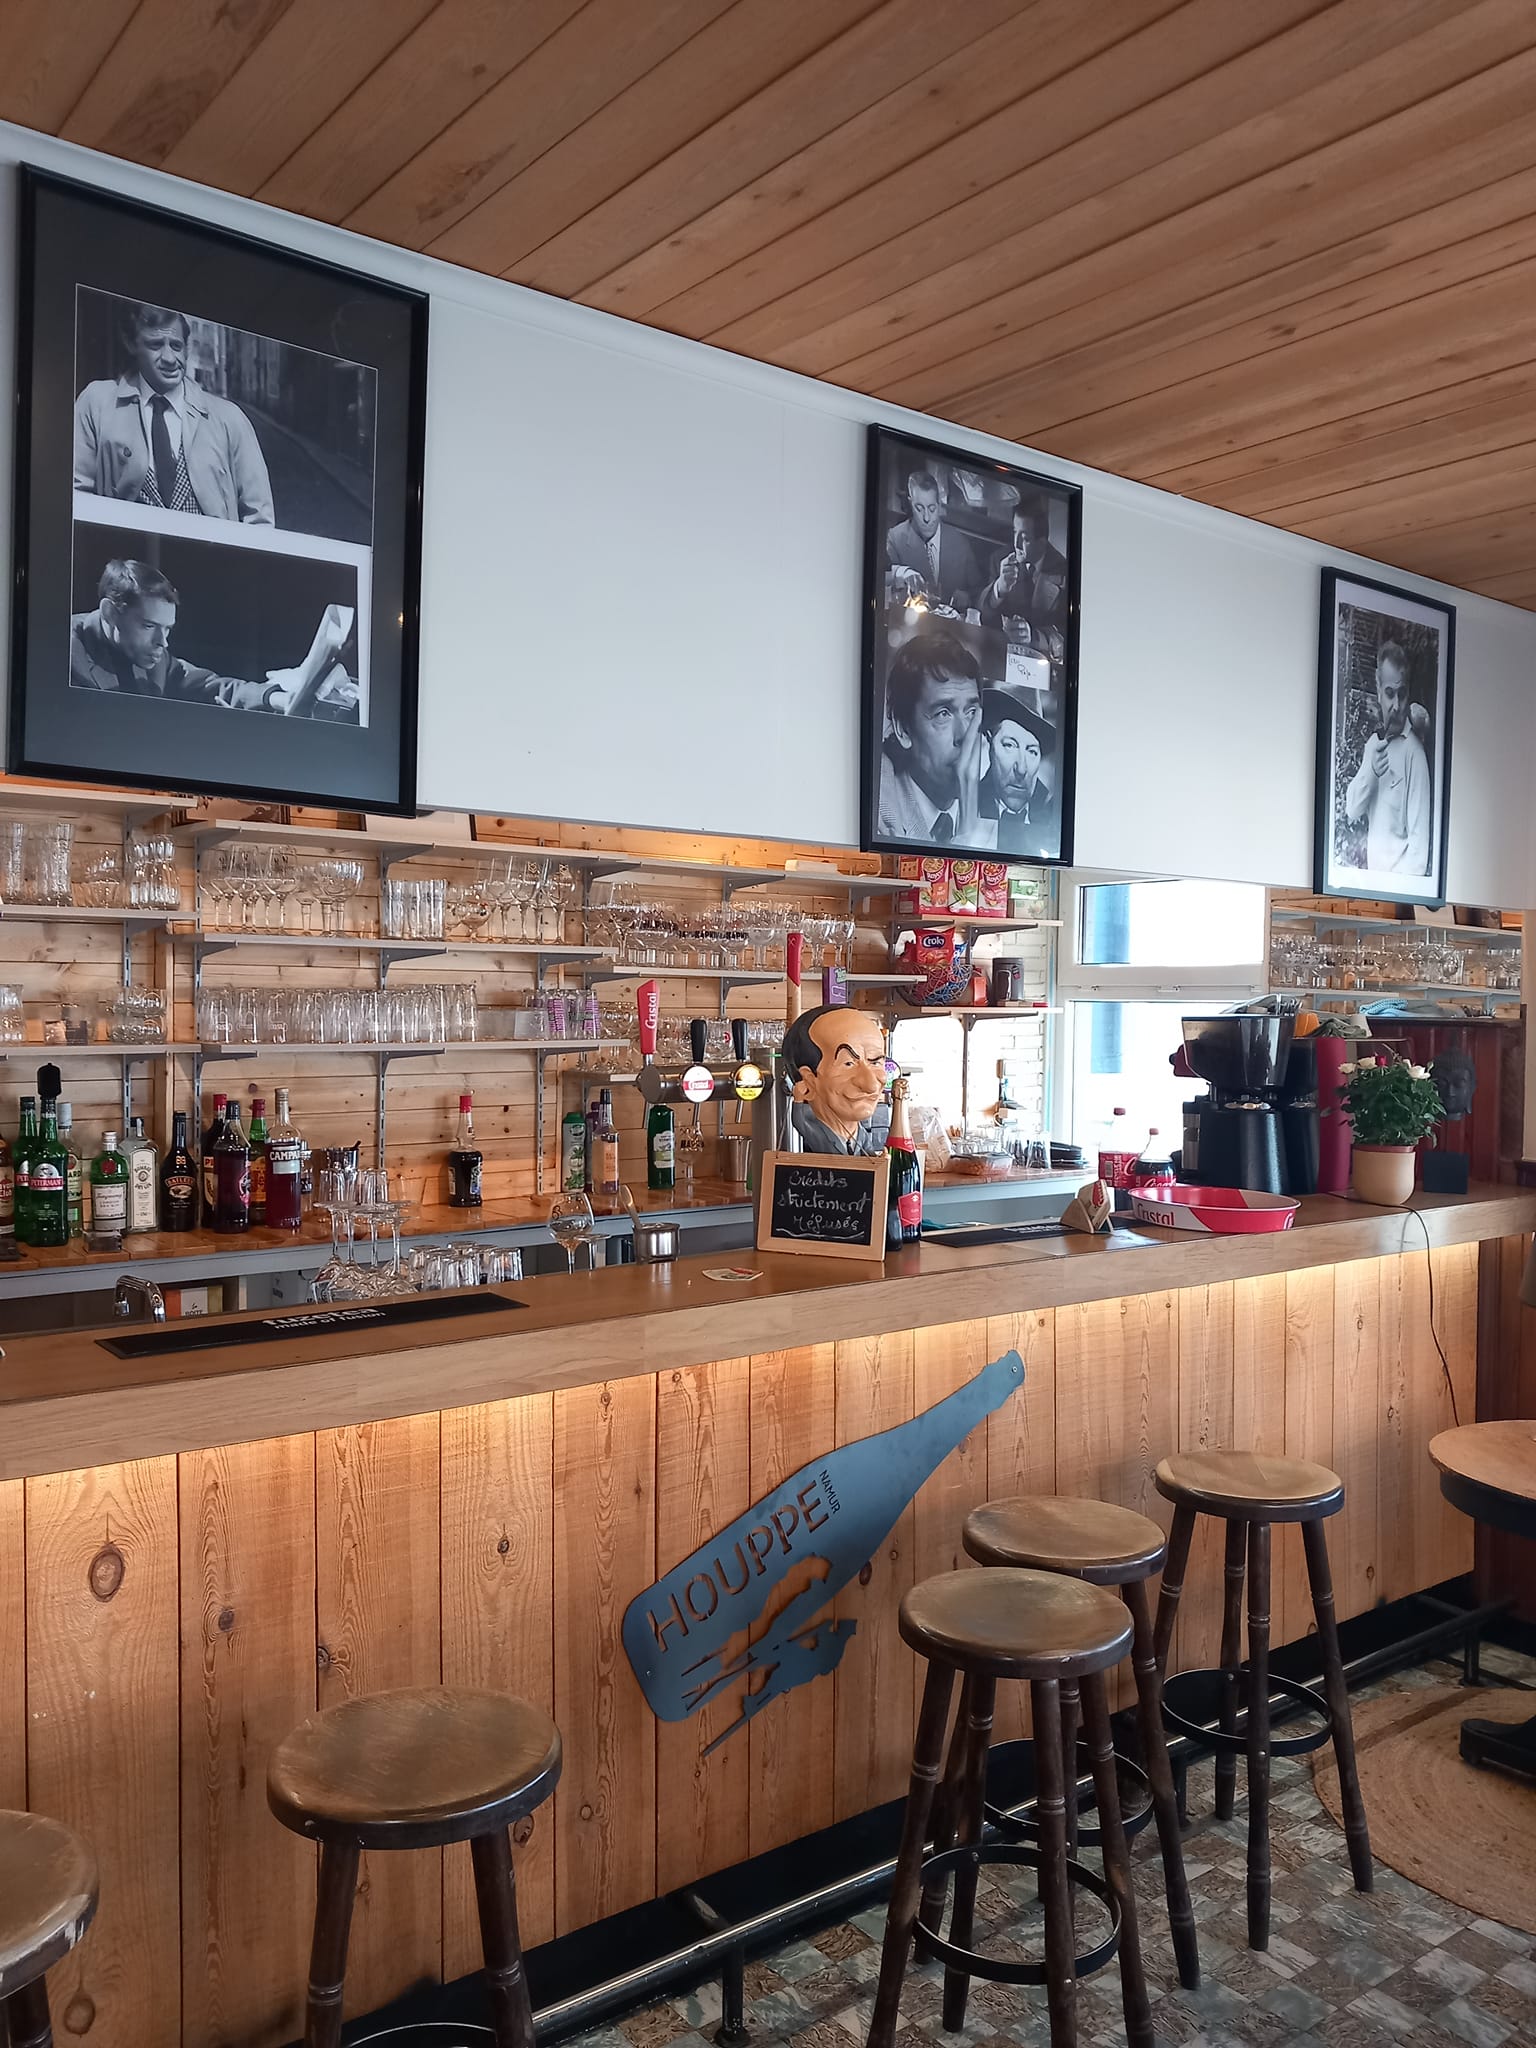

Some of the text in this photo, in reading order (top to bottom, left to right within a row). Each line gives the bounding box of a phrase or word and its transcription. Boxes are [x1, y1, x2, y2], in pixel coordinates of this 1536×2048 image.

[644, 992, 657, 1029] Cristal
[1137, 1203, 1175, 1226] Cristal
[320, 1316, 337, 1324] of
[338, 1311, 387, 1322] fusion
[819, 1469, 841, 1515] NAMUR
[646, 1480, 830, 1653] HOUPPE
